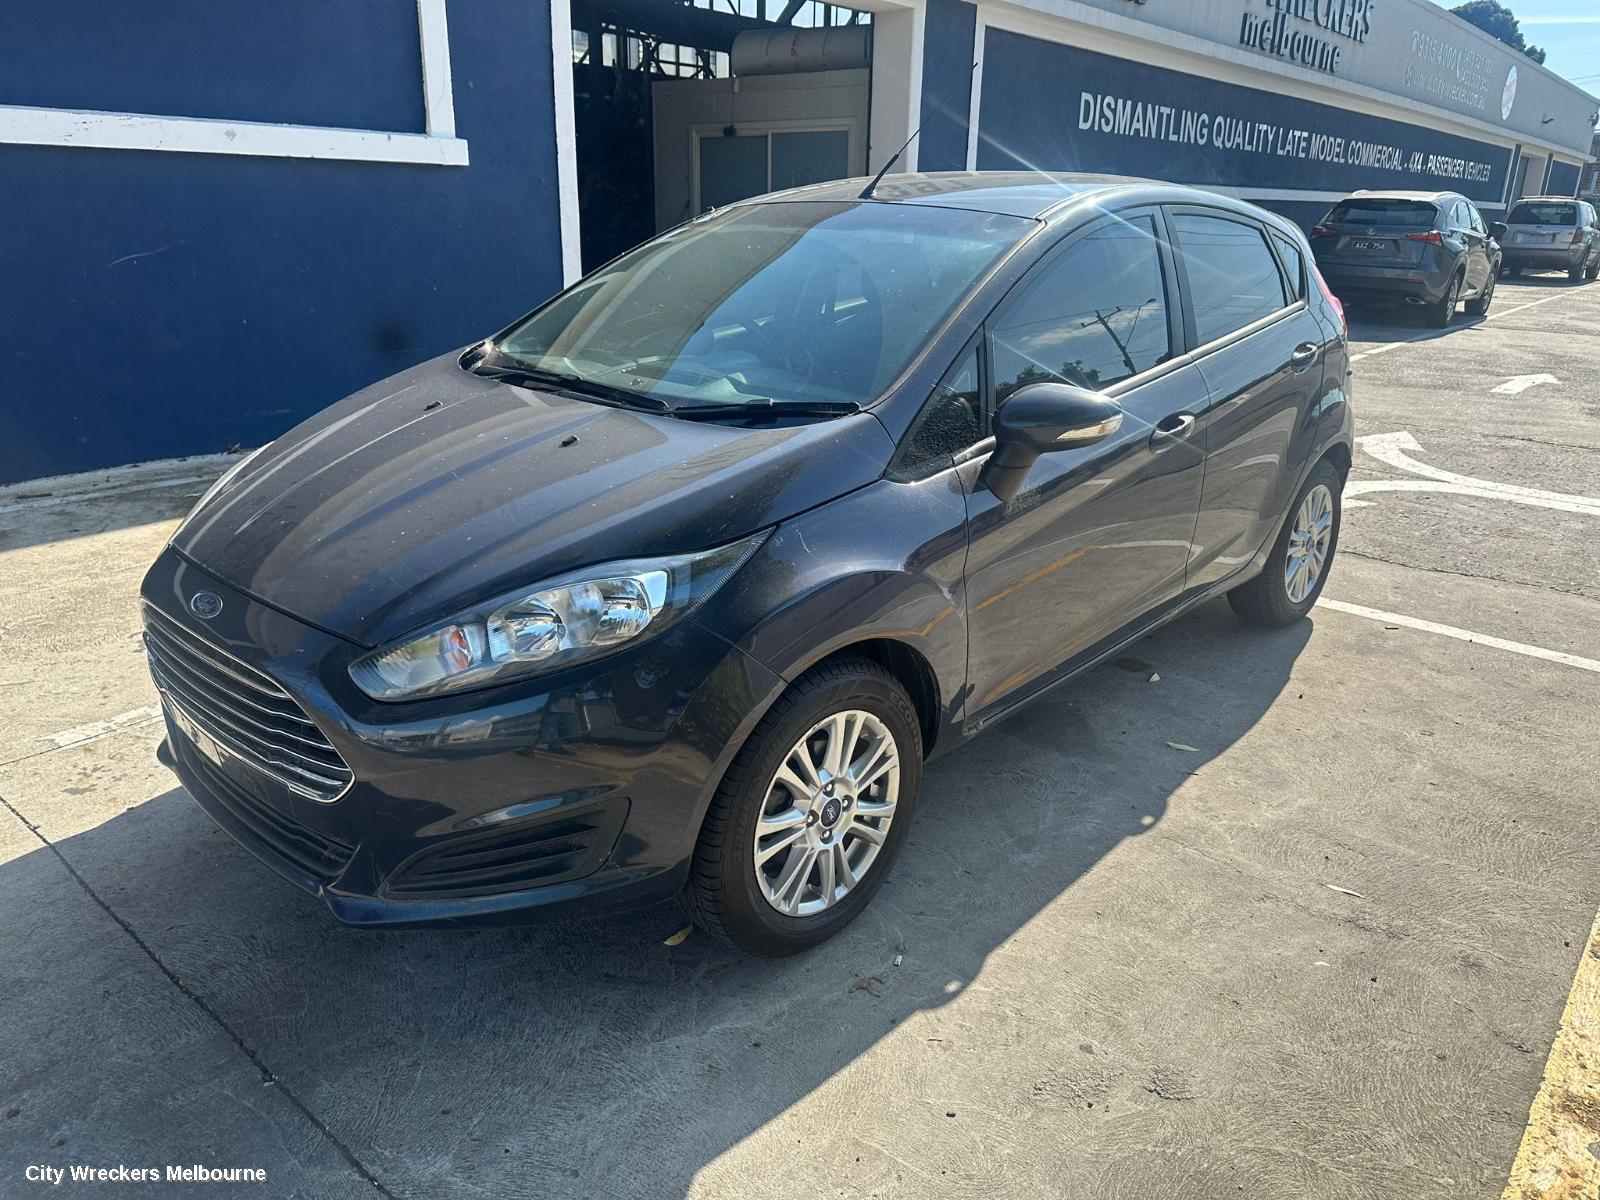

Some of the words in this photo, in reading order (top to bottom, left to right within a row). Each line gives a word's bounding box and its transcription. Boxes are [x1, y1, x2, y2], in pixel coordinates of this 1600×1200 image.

[1239, 11, 1340, 73] melbourne
[1078, 91, 1209, 145] DISMANTLING
[1213, 115, 1276, 154] QUALITY
[1276, 127, 1309, 158] LATE
[1309, 133, 1345, 164] MODEL
[1347, 139, 1403, 171] COMMERCIAL
[1409, 151, 1423, 173] 4X4
[1427, 153, 1464, 179] PASSENGER
[1465, 161, 1491, 182] VEHICLES
